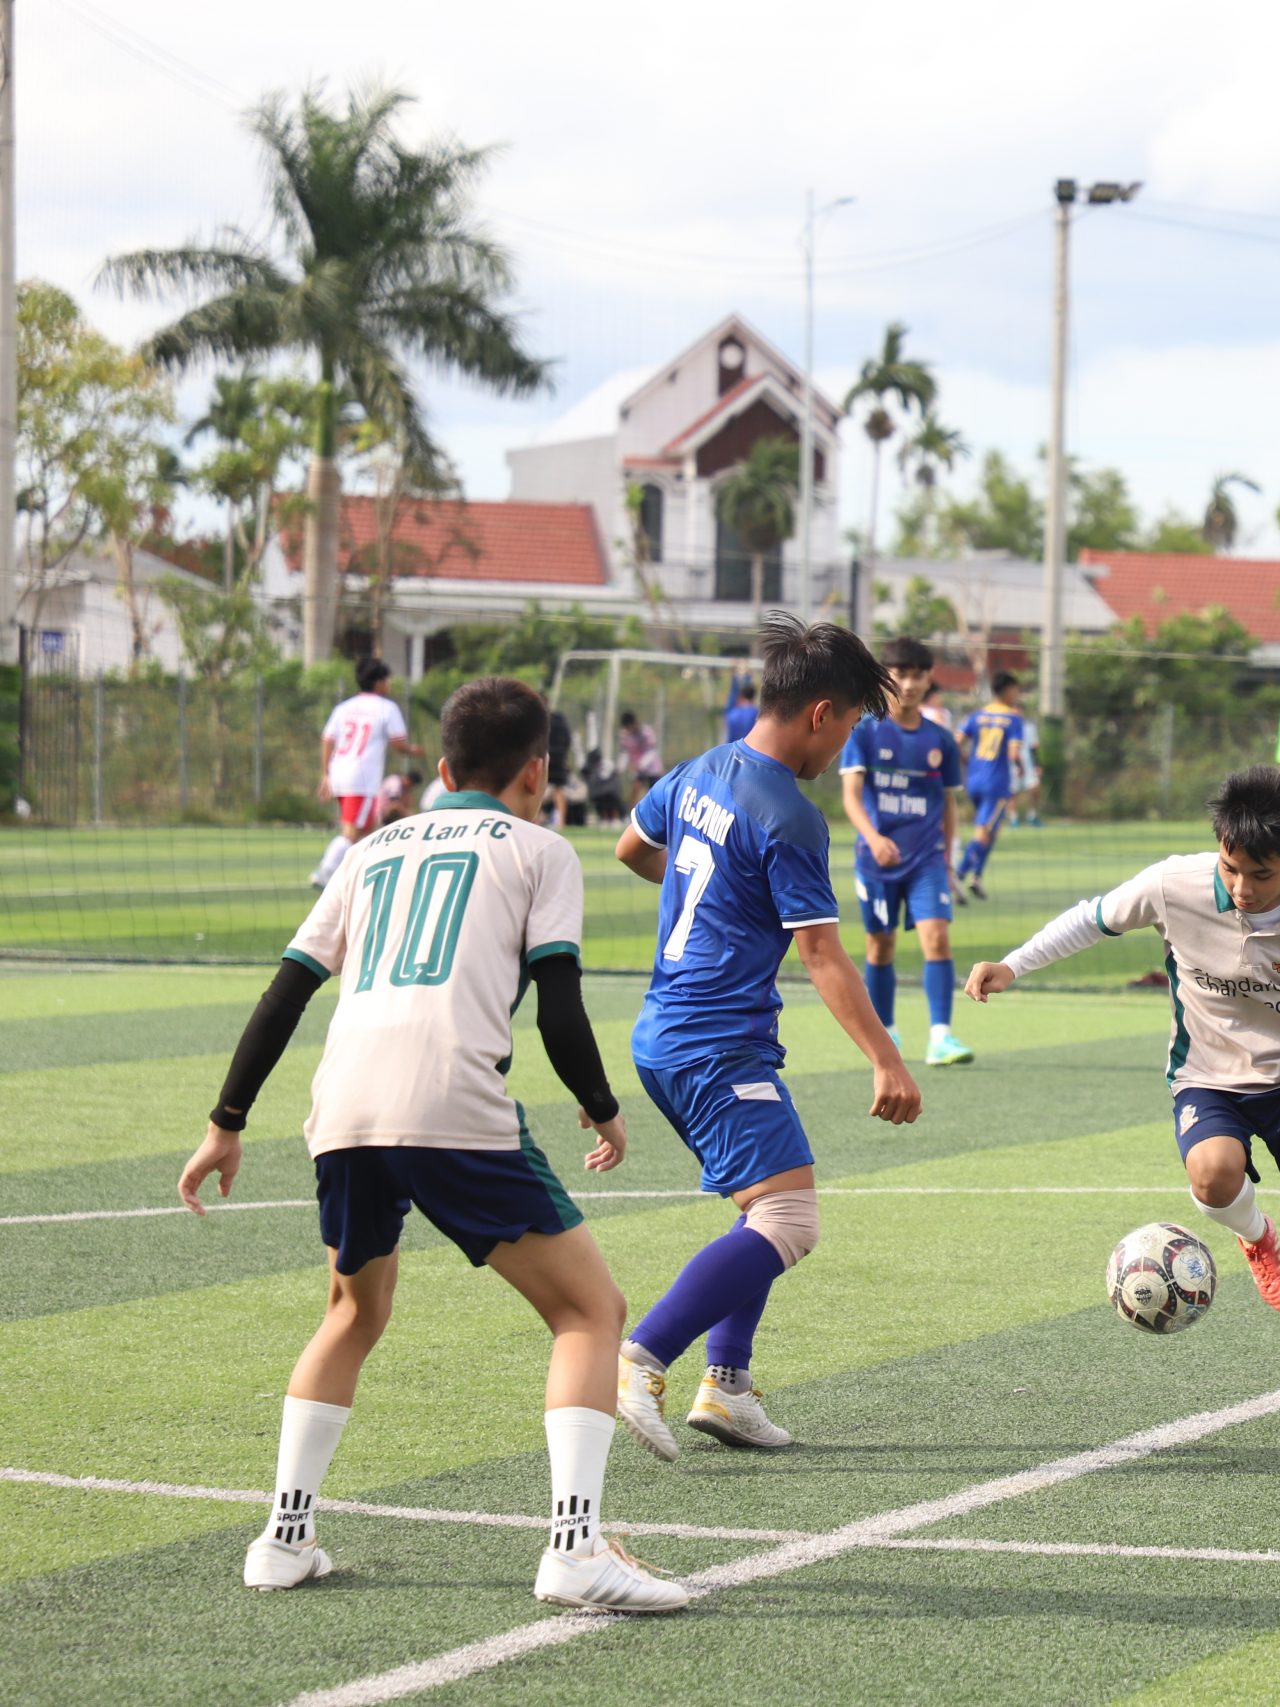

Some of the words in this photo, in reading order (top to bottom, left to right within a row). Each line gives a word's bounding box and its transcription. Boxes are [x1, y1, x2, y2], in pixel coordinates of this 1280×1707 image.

[336, 719, 373, 757] 31
[369, 823, 416, 847] Mộc
[422, 822, 469, 841] Lan
[474, 817, 513, 840] FC
[663, 834, 716, 962] 7
[353, 850, 481, 994] 10
[276, 1511, 310, 1523] SPORT
[554, 1515, 591, 1528] SPORT
